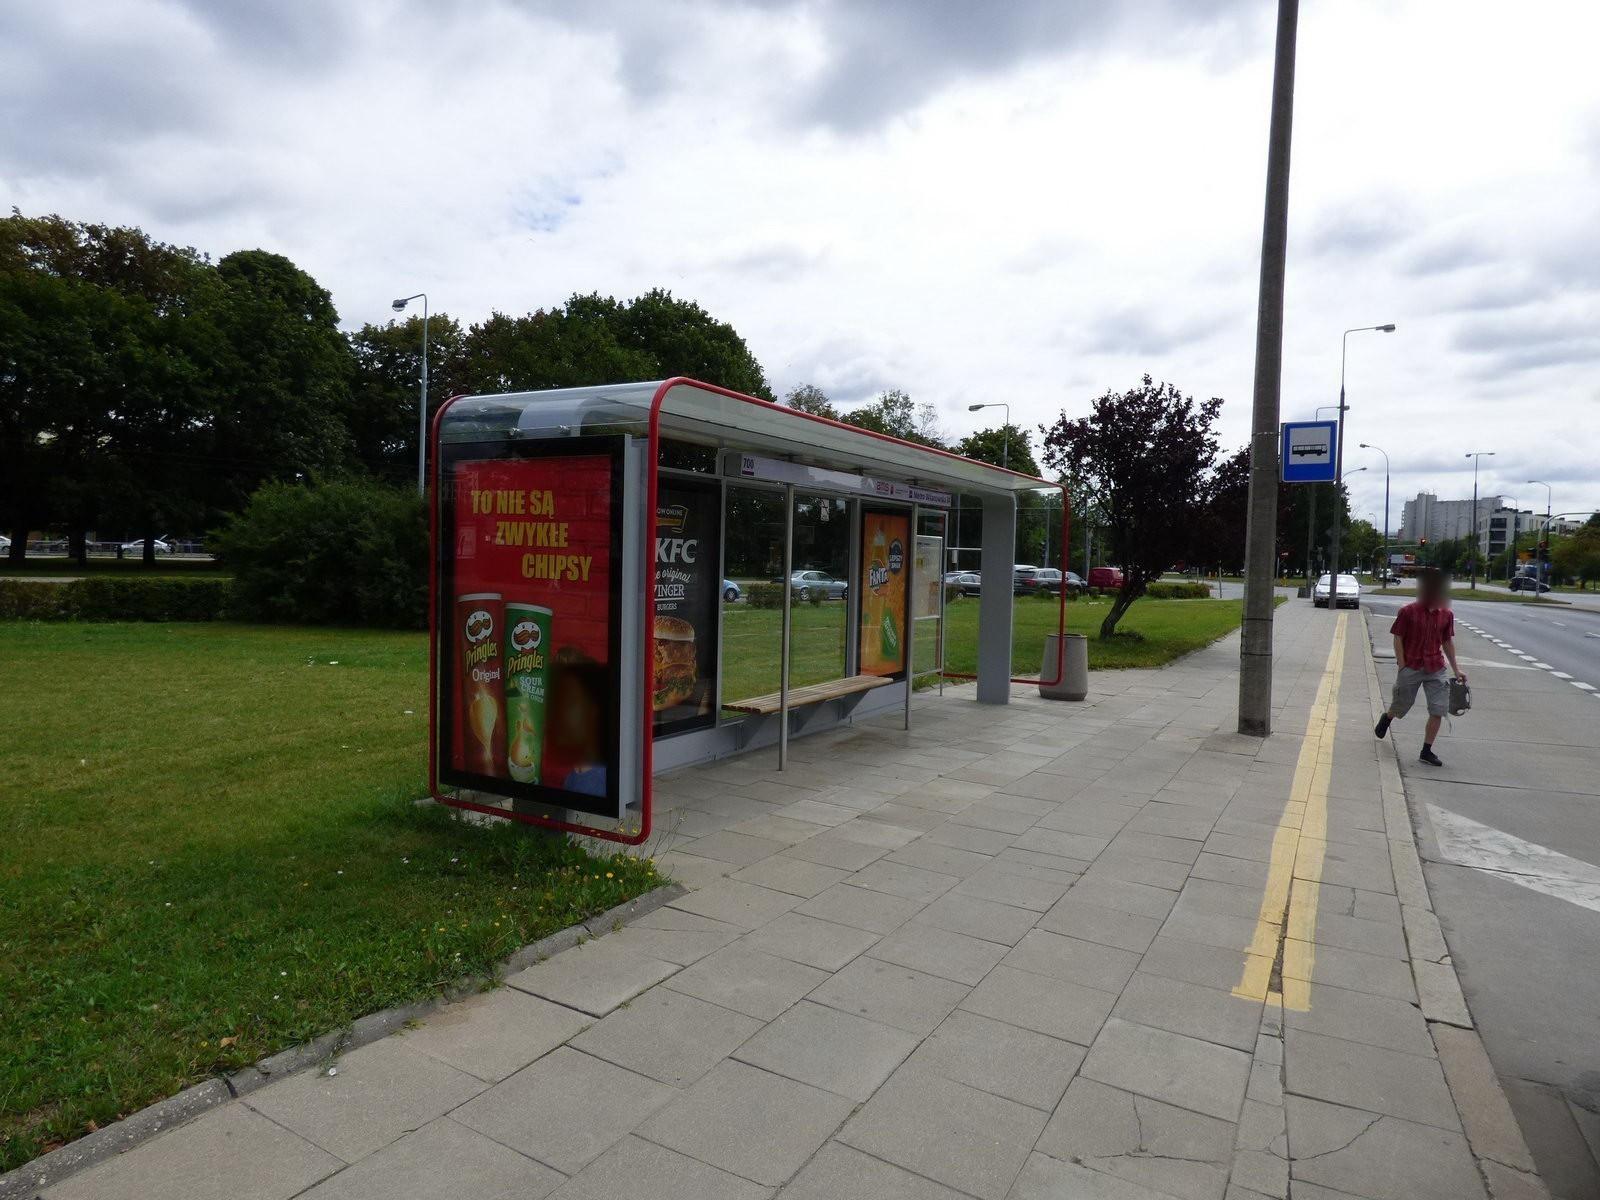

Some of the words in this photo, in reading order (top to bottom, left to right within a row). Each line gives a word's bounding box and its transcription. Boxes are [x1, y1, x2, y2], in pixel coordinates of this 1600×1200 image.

[471, 490, 493, 514] TO
[497, 490, 526, 515] NIE
[529, 490, 556, 519] SĄ
[496, 521, 569, 548] ZWYKŁE
[655, 538, 698, 564] KFC
[522, 553, 593, 581] CHIPSY
[465, 640, 498, 672] Pringles
[508, 651, 544, 678] Pringles
[472, 668, 500, 683] Original
[520, 677, 543, 686] SOUR
